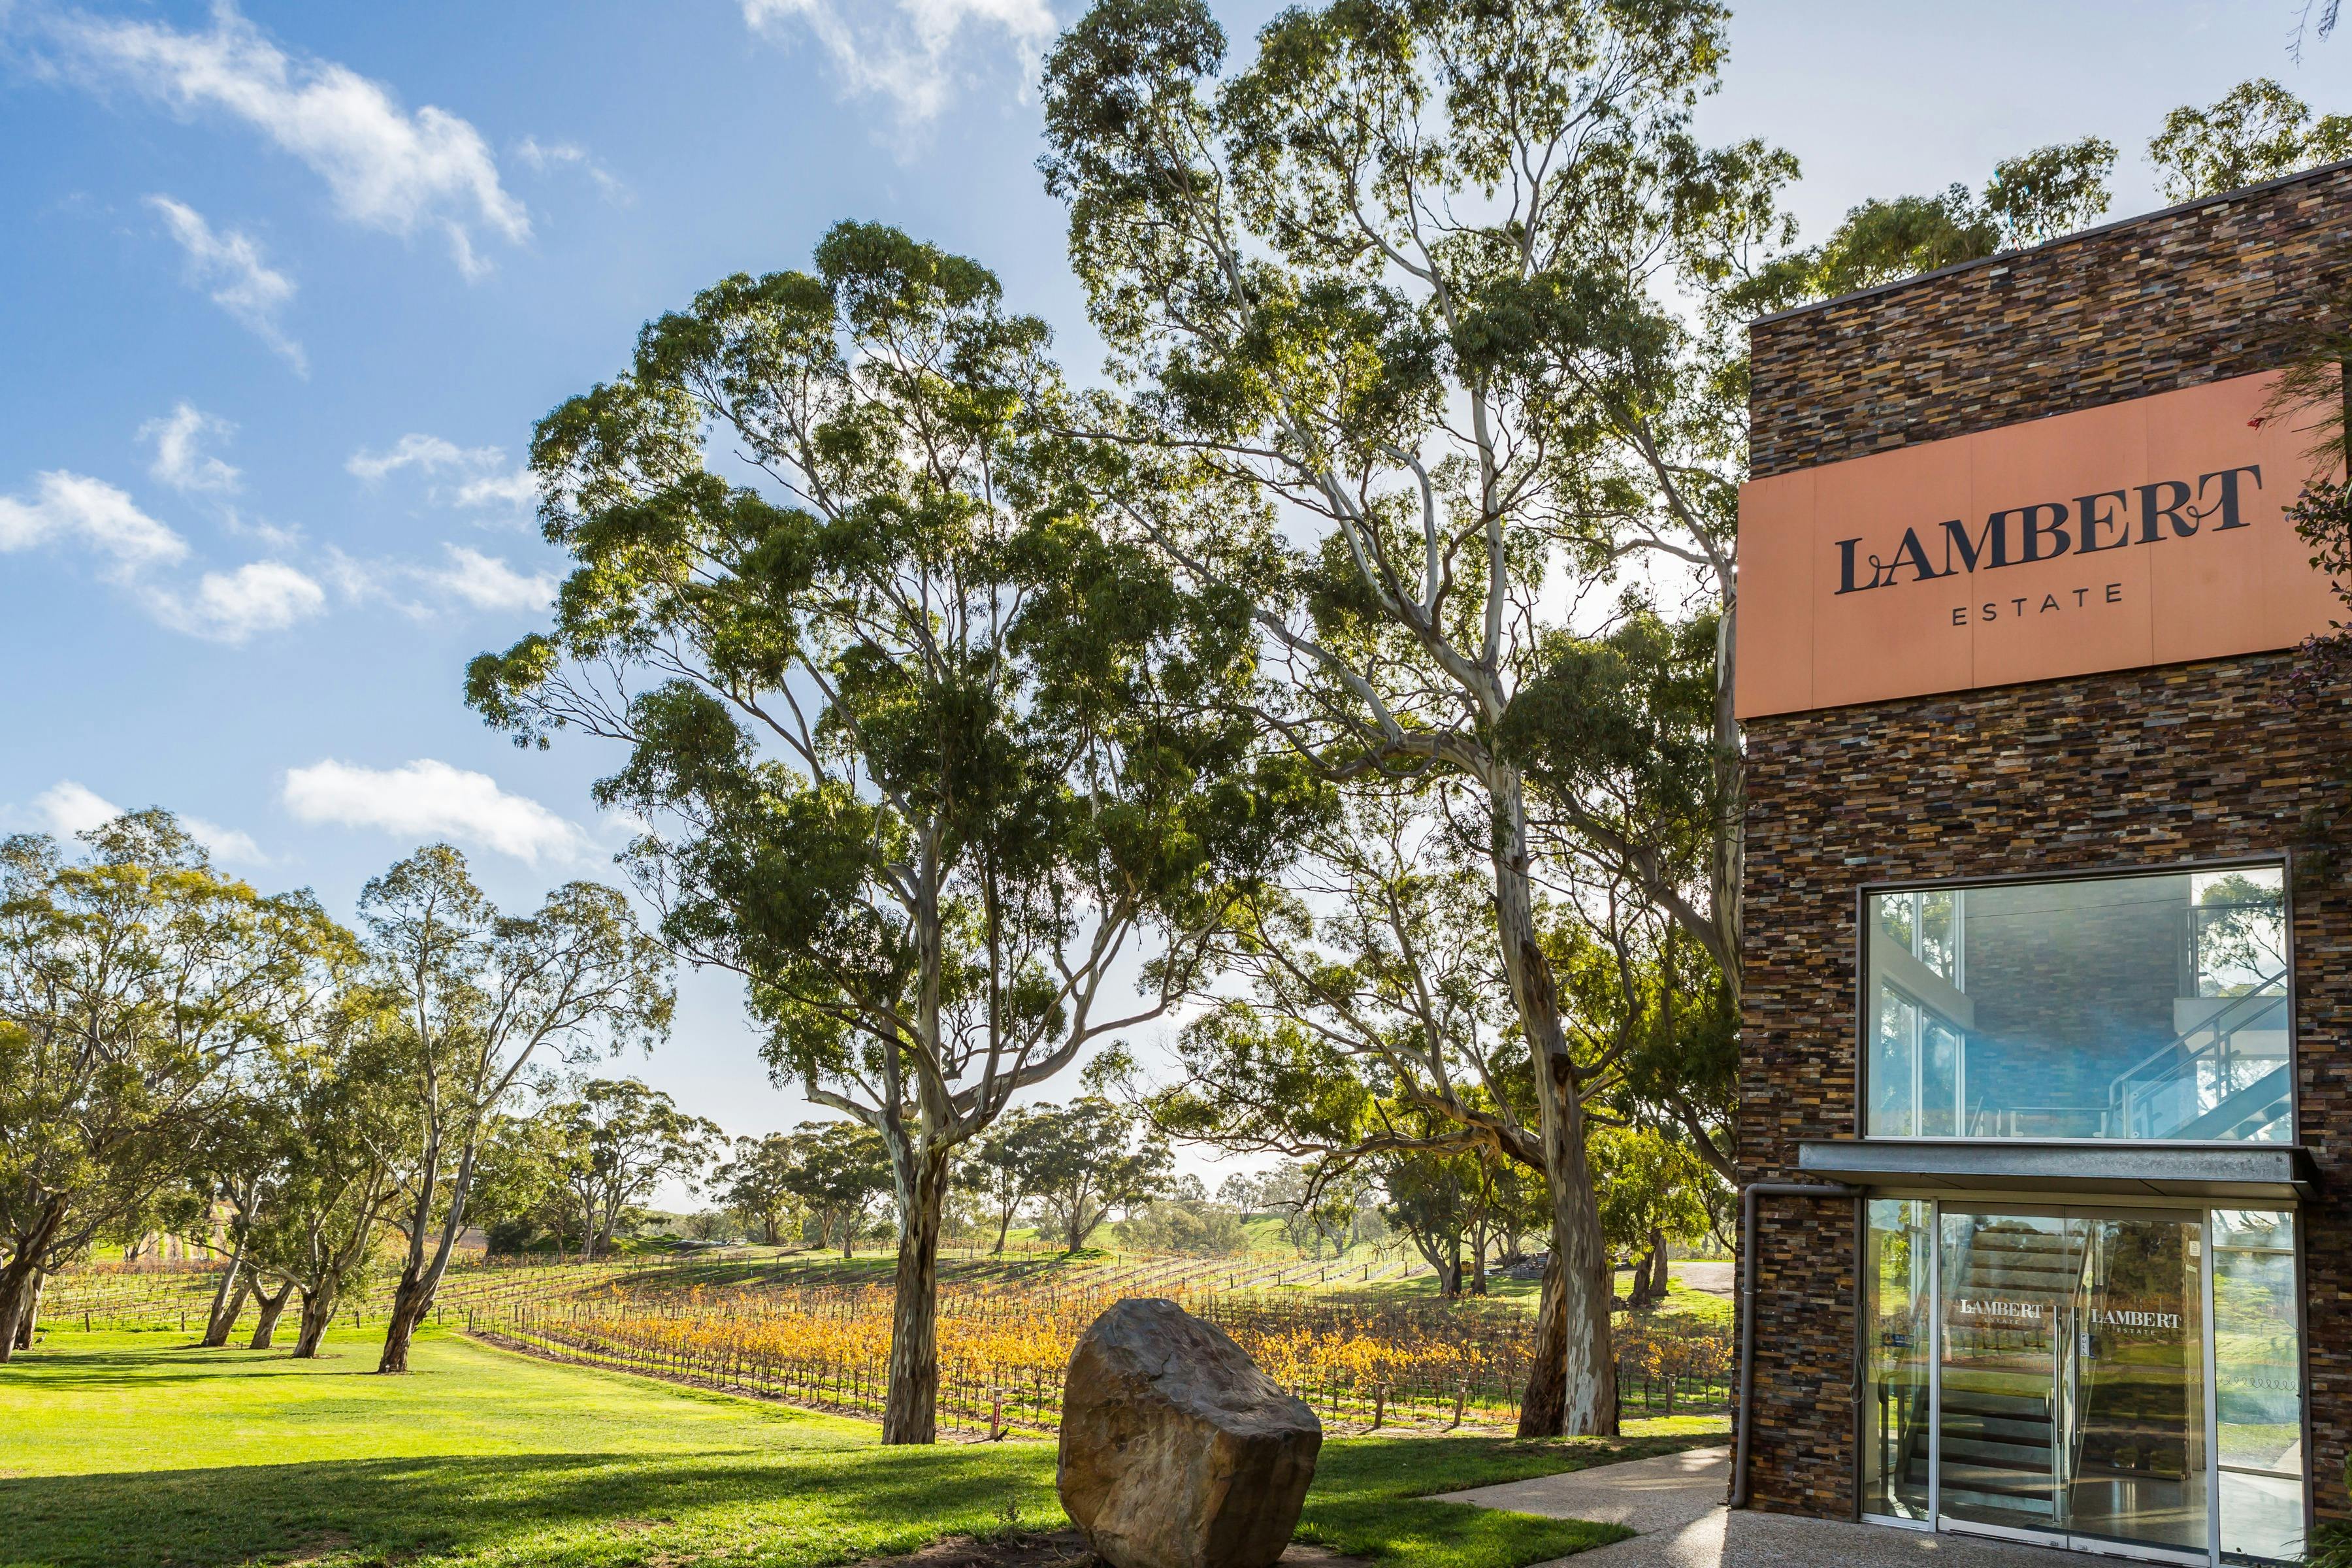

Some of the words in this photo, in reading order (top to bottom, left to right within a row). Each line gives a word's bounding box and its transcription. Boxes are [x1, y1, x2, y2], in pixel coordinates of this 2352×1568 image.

[1834, 464, 2262, 595] LAMBERT
[1952, 583, 2122, 626] ESTATE
[1960, 1299, 2043, 1318] LAMBERT
[2091, 1309, 2181, 1328] LAMBERT
